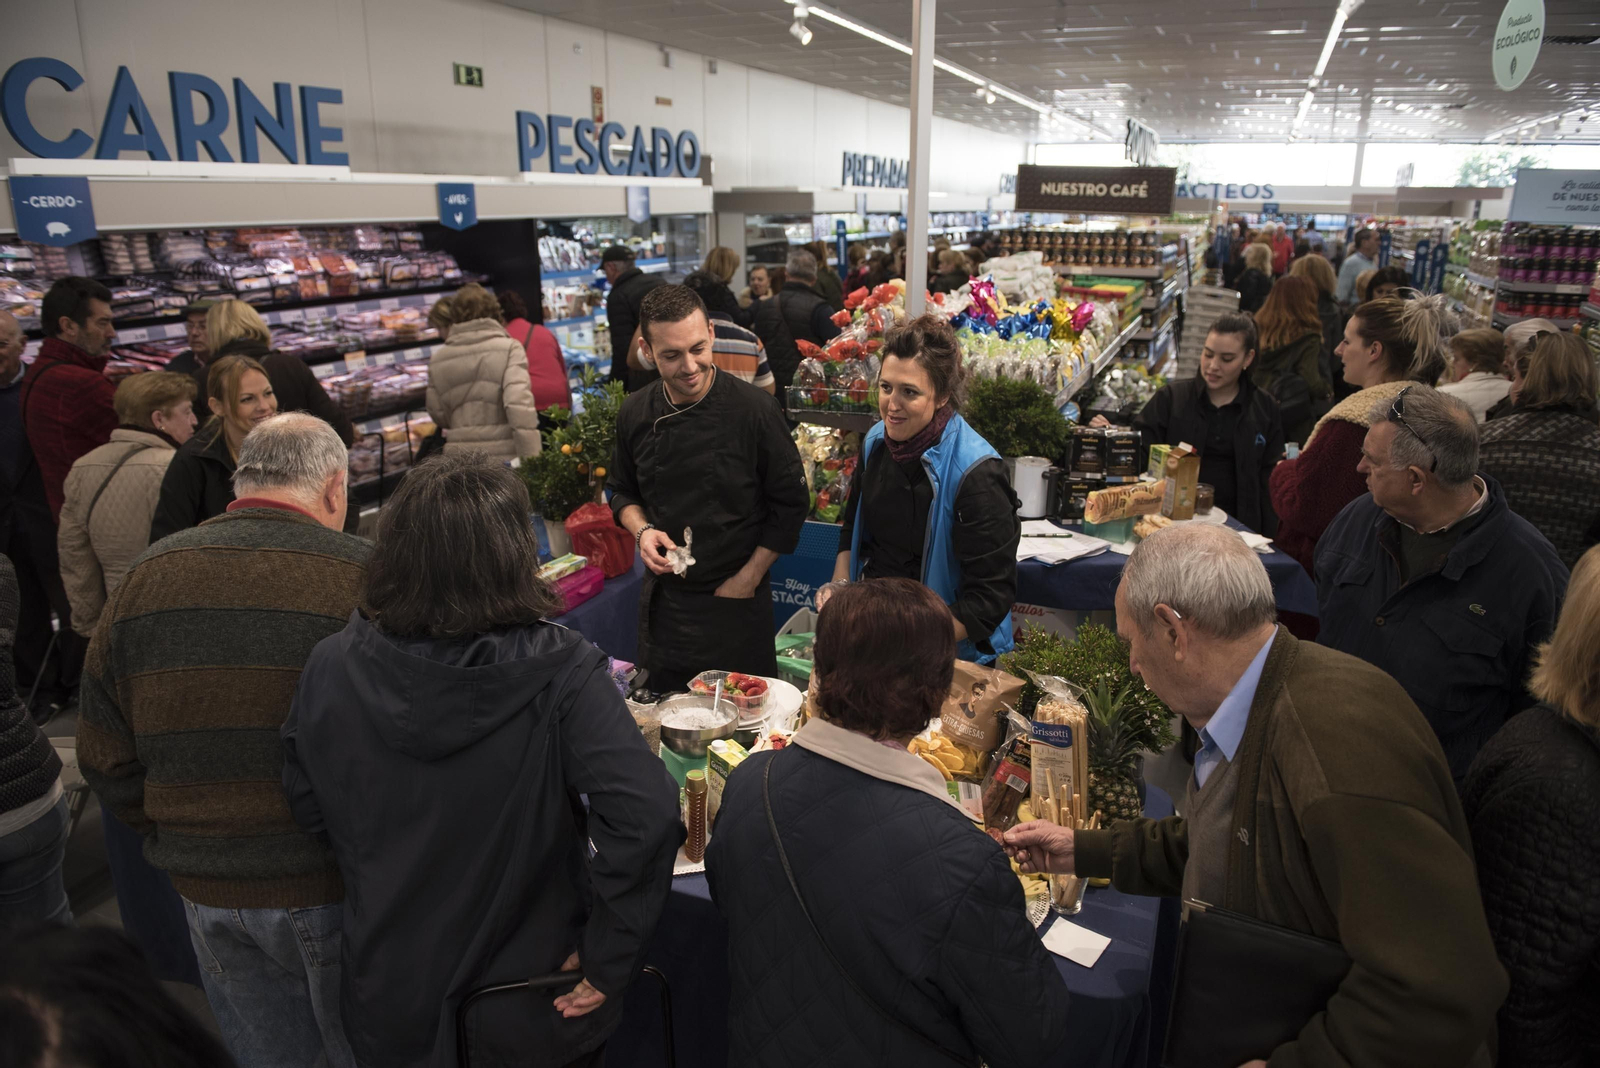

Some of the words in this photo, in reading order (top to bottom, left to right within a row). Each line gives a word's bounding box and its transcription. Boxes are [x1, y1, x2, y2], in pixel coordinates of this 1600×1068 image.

[1507, 13, 1533, 28] Producto
[1496, 28, 1541, 50] ECOLÓGICO
[0, 57, 350, 166] CARNE
[516, 110, 701, 178] PESCADO
[842, 151, 909, 189] PREPARA
[1041, 182, 1107, 197] NUESTRO
[1110, 181, 1149, 198] CAFÉ
[1553, 192, 1567, 201] DE
[1570, 193, 1600, 201] NUES
[785, 578, 811, 595] Hoy
[772, 590, 816, 607] STACA
[942, 713, 985, 740] EXTRA-GRUESAS
[1031, 725, 1069, 738] Grissotti
